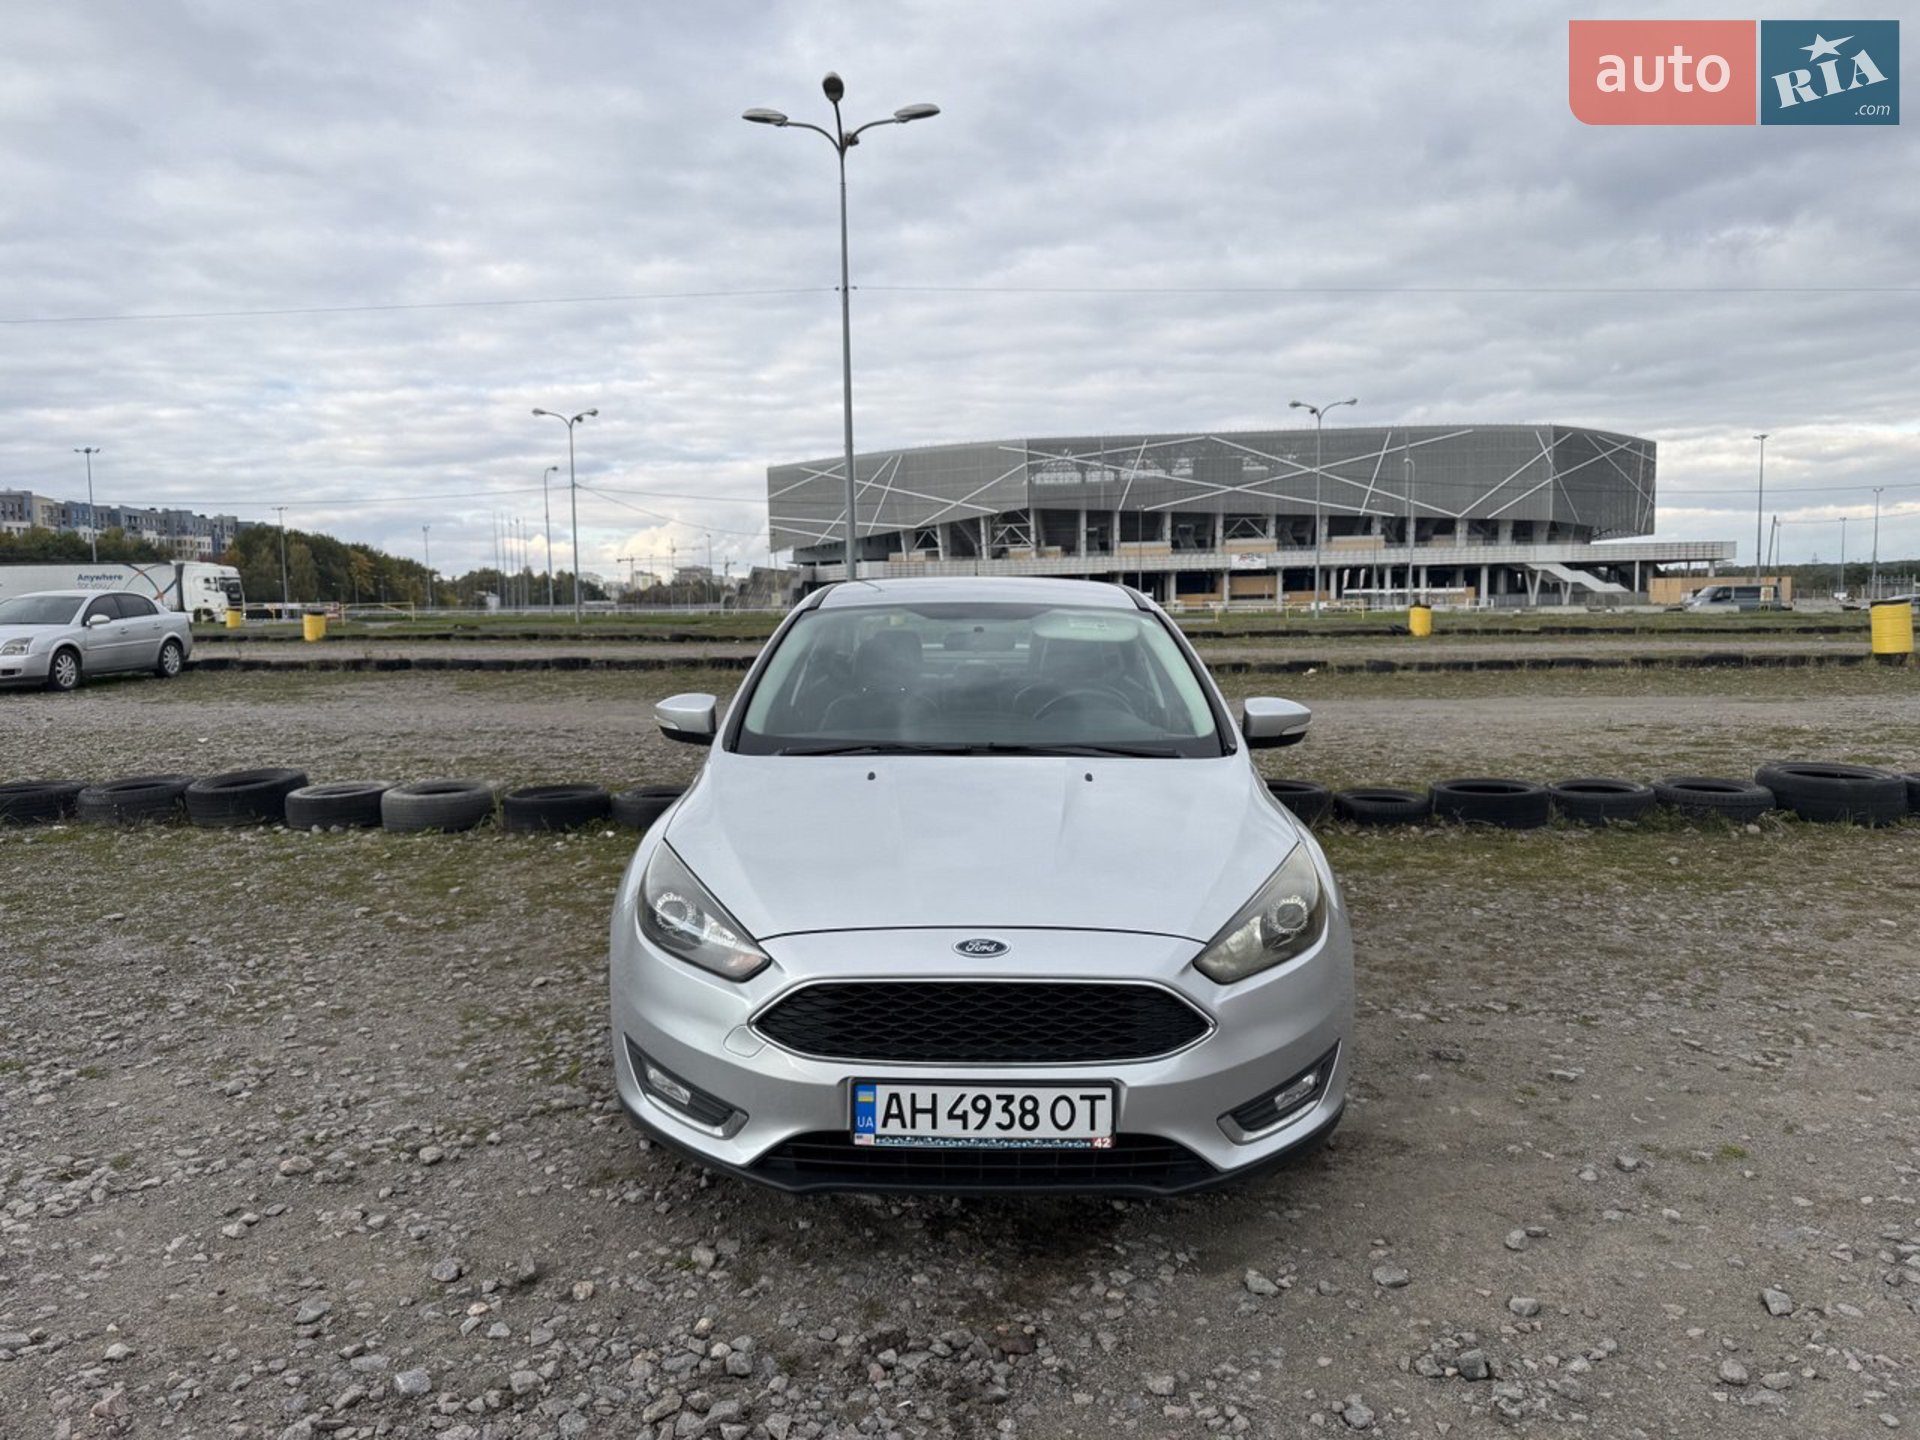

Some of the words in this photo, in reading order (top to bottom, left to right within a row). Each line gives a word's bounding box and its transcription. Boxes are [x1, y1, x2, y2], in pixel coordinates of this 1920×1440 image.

[77, 573, 124, 582] Anywhere
[857, 1116, 874, 1128] UA
[1093, 1138, 1112, 1148] 42
